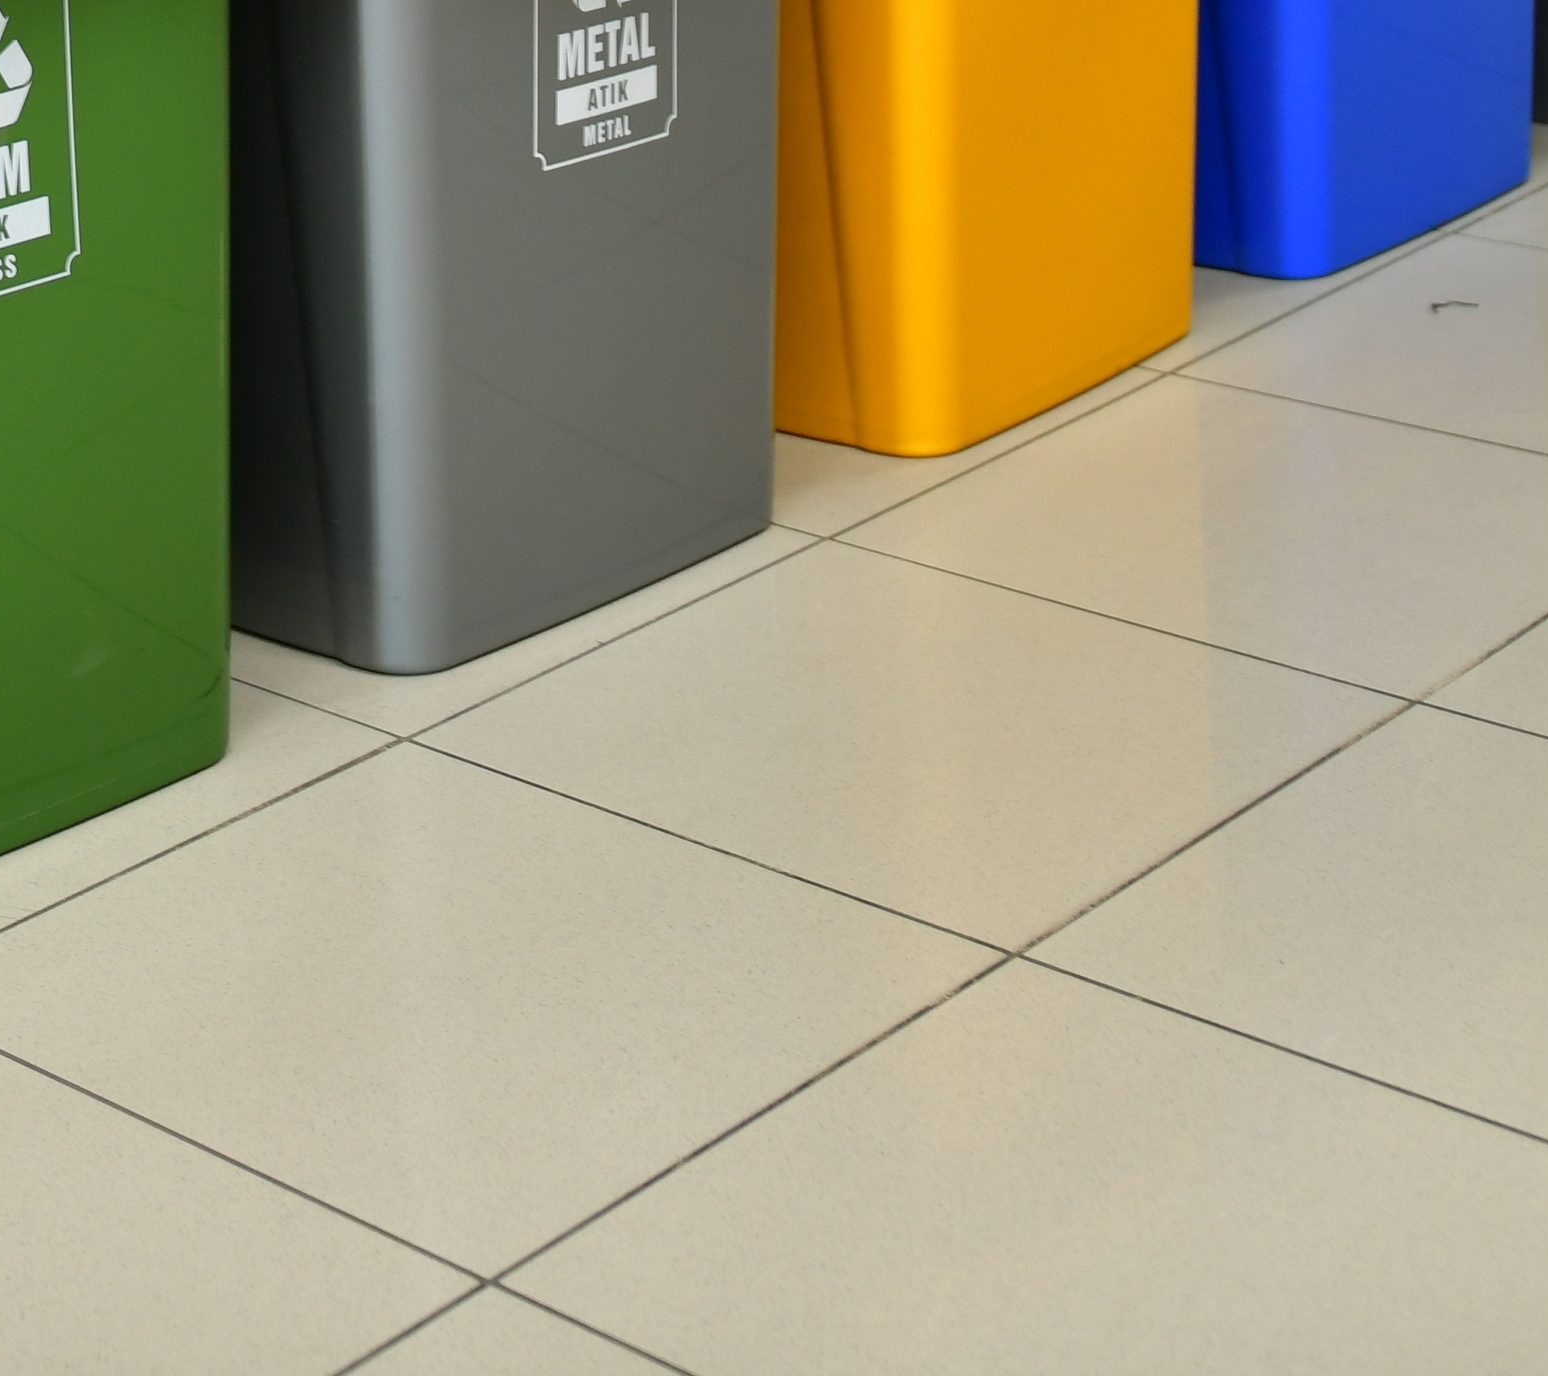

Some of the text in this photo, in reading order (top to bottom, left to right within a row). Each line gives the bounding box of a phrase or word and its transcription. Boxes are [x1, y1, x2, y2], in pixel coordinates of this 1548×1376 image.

[557, 12, 656, 81] METAL
[587, 79, 629, 111] ATIK
[583, 115, 632, 147] METAL
